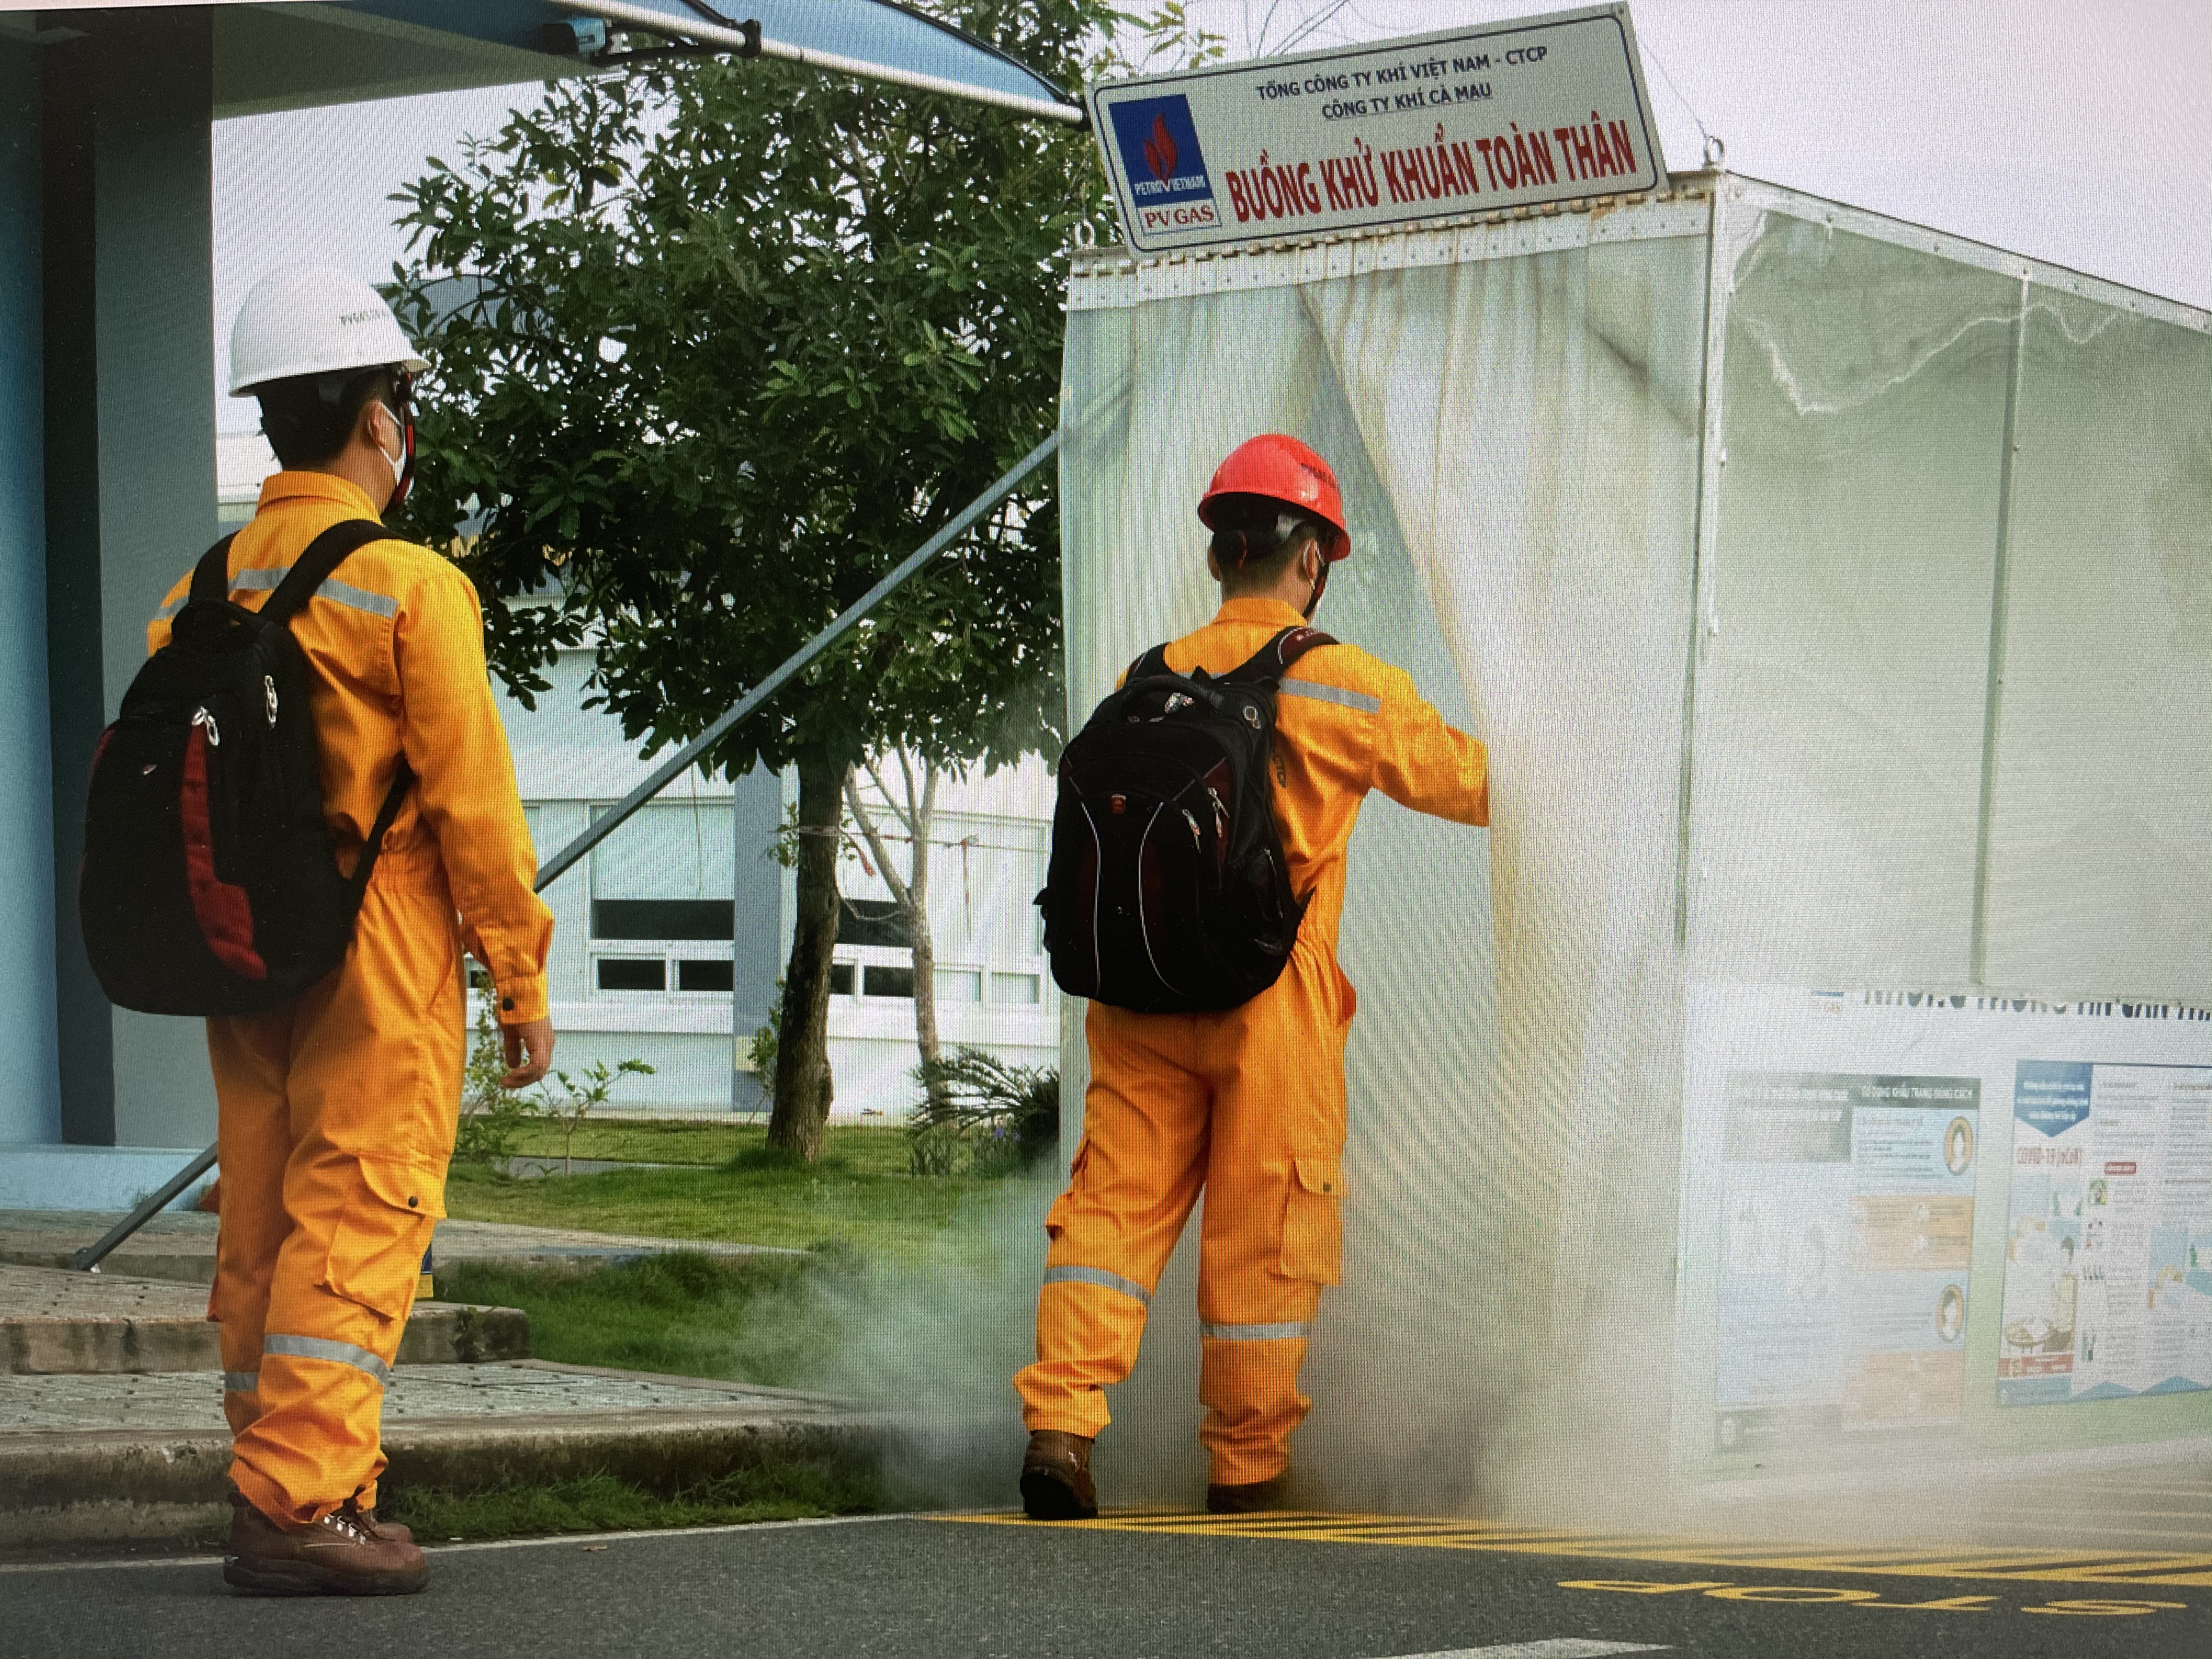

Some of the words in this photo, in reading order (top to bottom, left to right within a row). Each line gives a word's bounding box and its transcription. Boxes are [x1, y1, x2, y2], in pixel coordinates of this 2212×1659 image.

[1304, 74, 1349, 94] CÔNG
[1351, 71, 1371, 87] TY
[1376, 61, 1407, 83] KHÍ
[1410, 57, 1447, 80] VIỆT
[1452, 54, 1489, 72] NAM
[1506, 46, 1548, 65] CTCP
[1322, 98, 1368, 119] CÔNG
[1370, 96, 1389, 112] TY
[1394, 87, 1426, 108] KHÍ
[1454, 82, 1493, 101] MAU
[1225, 148, 1322, 223] BUỒNG
[1319, 137, 1379, 211] KHỬ
[1380, 121, 1480, 203] KHUẨN
[1475, 122, 1558, 191] TOÀN
[1553, 110, 1637, 181] THÂN
[1145, 210, 1169, 228] PV
[1174, 205, 1214, 224] GAS
[1556, 1578, 2189, 1615] STOP
